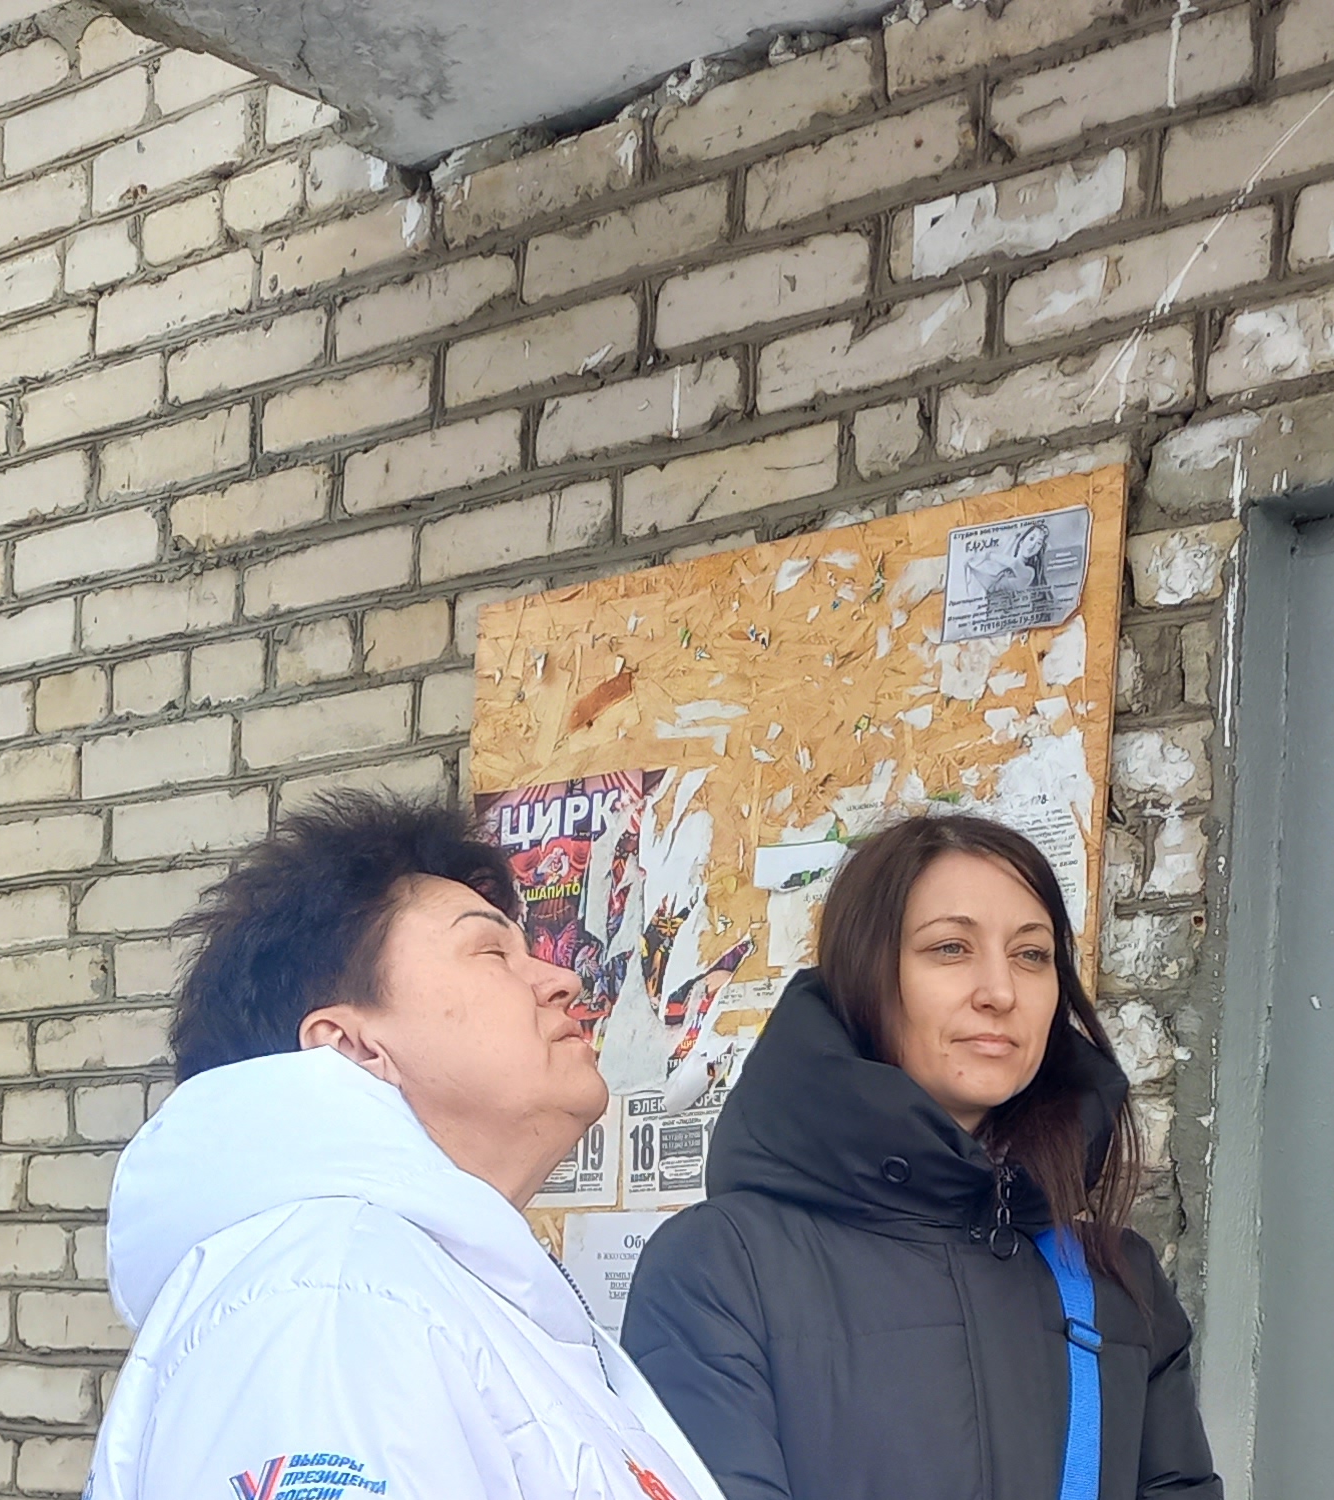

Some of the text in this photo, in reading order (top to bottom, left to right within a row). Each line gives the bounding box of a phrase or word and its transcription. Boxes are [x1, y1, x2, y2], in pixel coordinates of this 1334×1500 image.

[501, 789, 620, 851] ЦИРК
[526, 882, 581, 902] ШАПИТО
[582, 1124, 604, 1171] 19
[630, 1123, 655, 1171] 18
[289, 1453, 365, 1472] ВЫБОРЫ
[280, 1471, 387, 1495] ПРЕЗИДЕНТА
